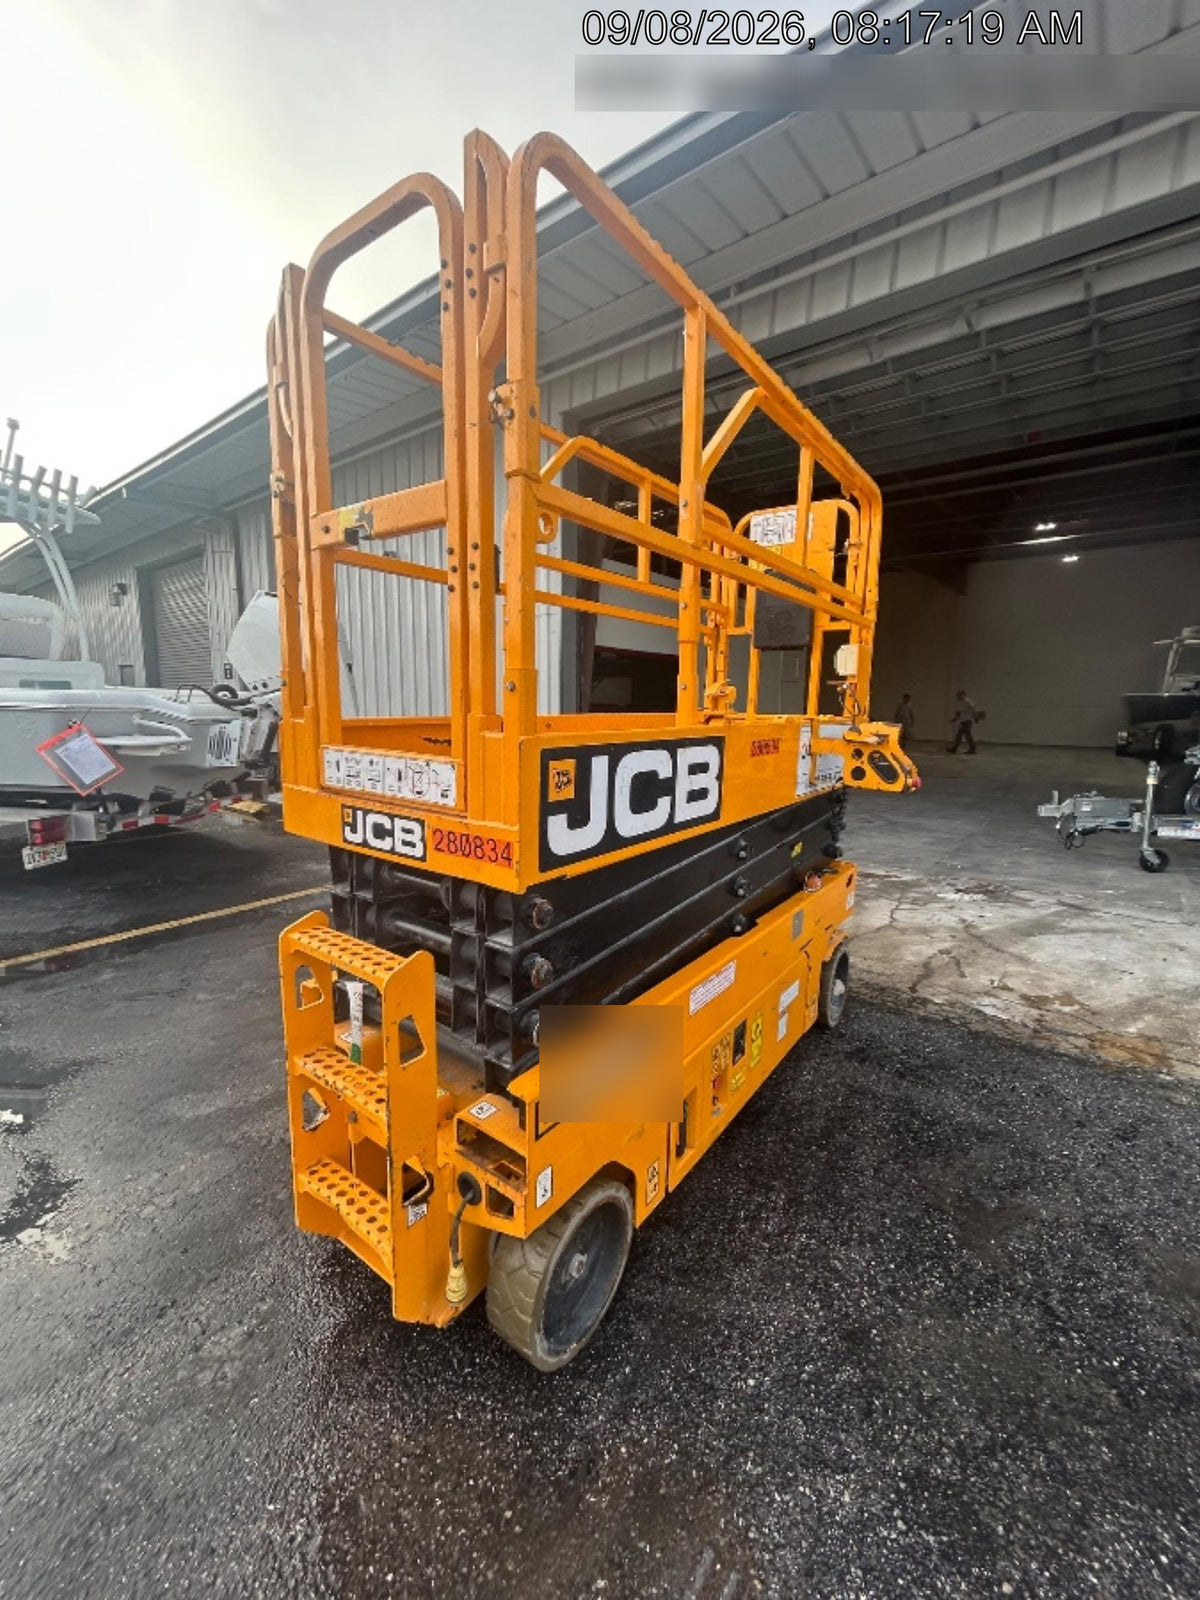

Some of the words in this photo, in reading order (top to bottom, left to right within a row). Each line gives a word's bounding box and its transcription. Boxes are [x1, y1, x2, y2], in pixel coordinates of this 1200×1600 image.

[547, 744, 721, 856] JCB
[344, 809, 424, 859] JCB
[432, 828, 513, 867] 280834
